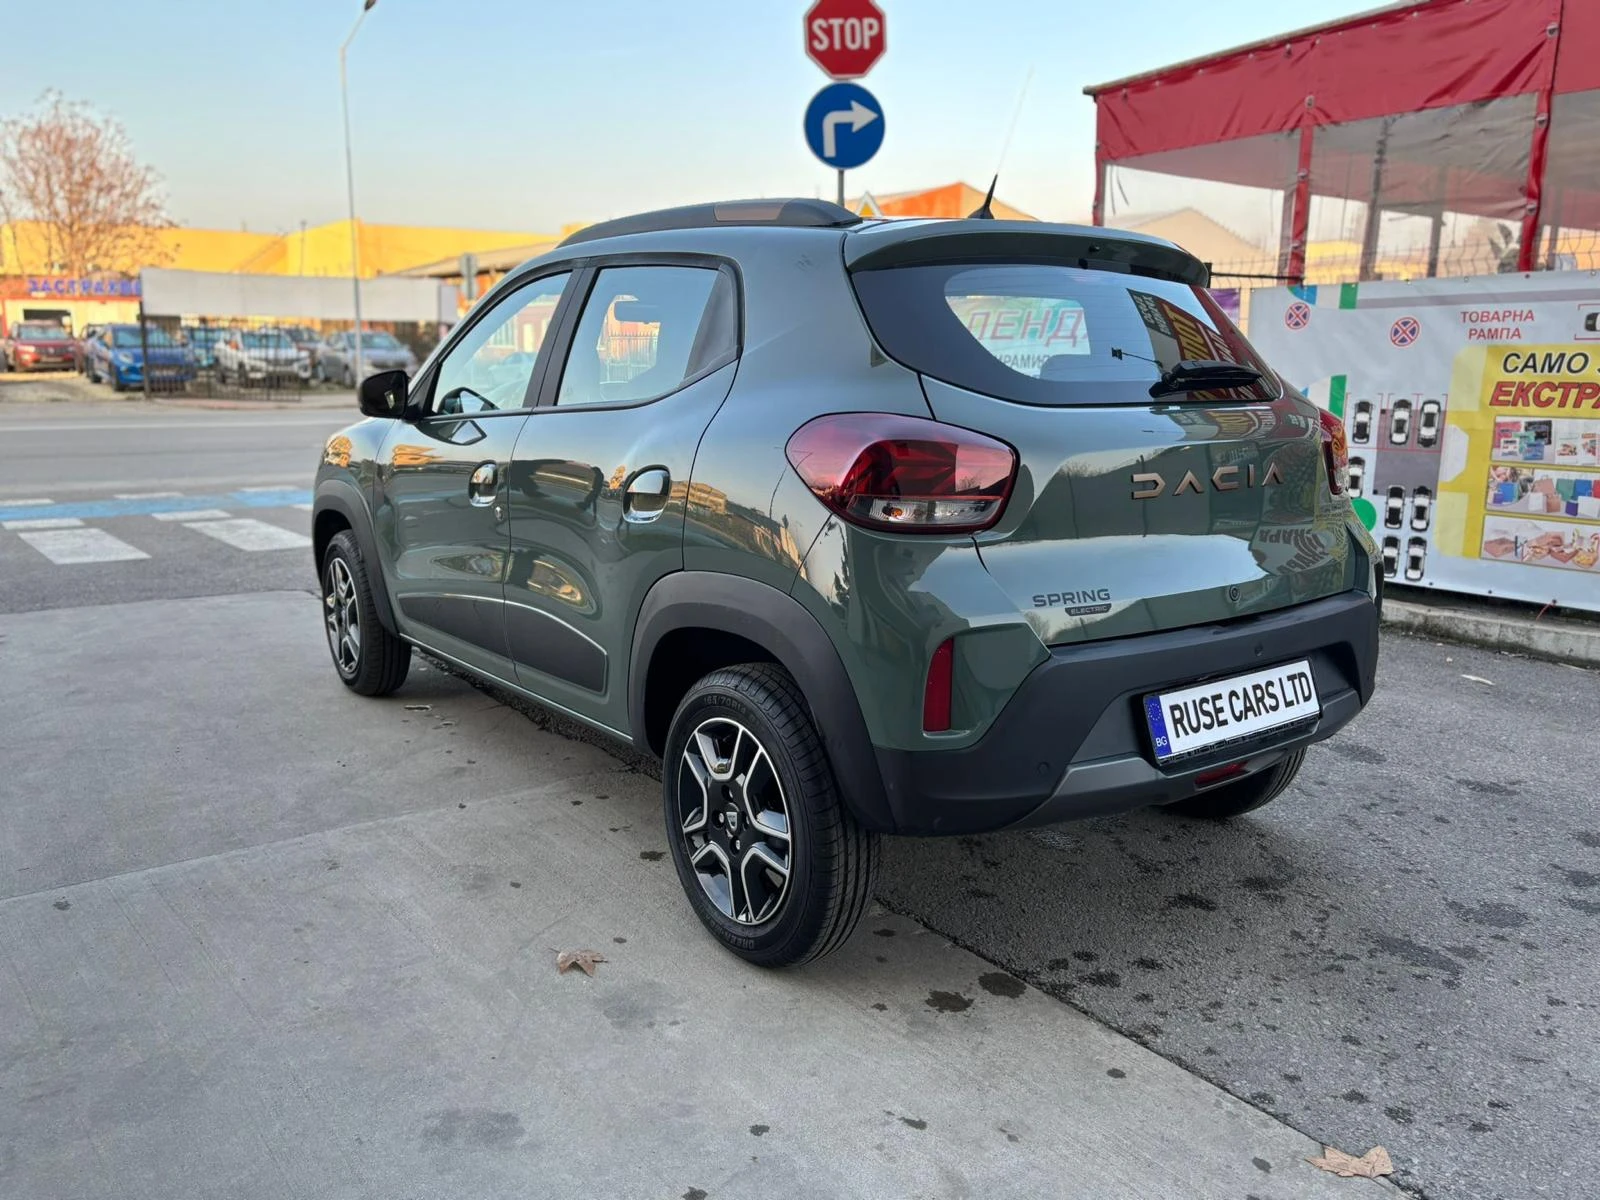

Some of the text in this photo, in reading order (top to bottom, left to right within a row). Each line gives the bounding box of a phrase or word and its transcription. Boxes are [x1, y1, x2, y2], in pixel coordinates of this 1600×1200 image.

[811, 16, 880, 51] STOP
[1461, 310, 1534, 323] ТОВАРНА
[1468, 328, 1521, 339] РАМПА
[1503, 353, 1589, 373] САМО
[1131, 462, 1284, 500] DACIA
[1032, 588, 1111, 608] SPRING
[1070, 604, 1108, 615] ELECTRIC
[1169, 671, 1313, 739] RUSE CARS LTD
[1155, 735, 1168, 748] BG
